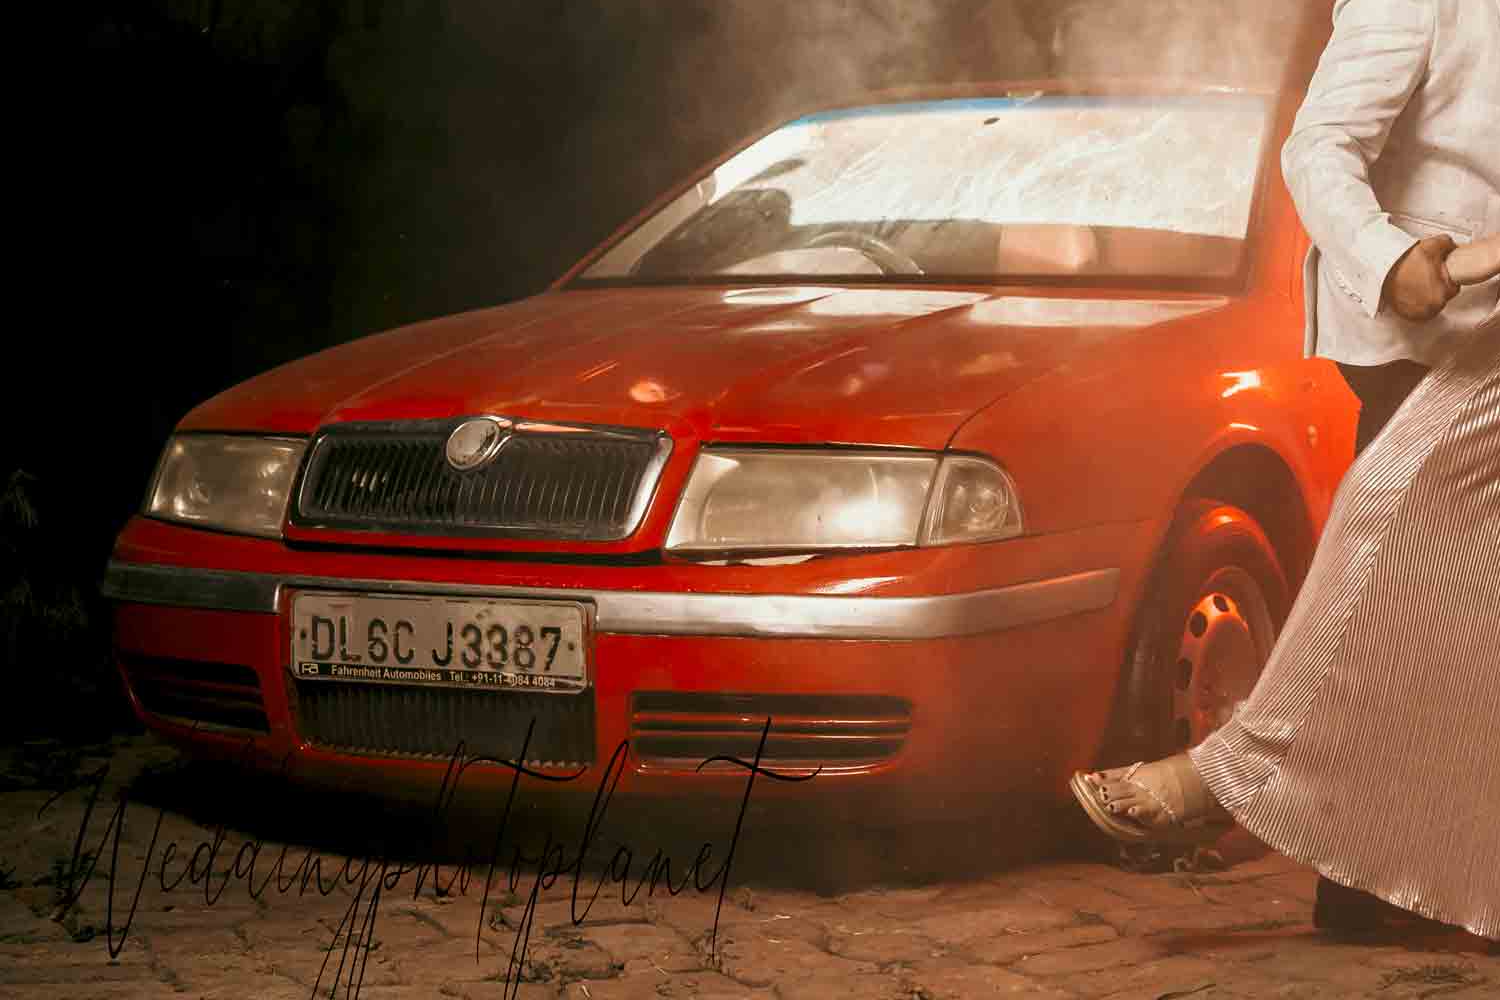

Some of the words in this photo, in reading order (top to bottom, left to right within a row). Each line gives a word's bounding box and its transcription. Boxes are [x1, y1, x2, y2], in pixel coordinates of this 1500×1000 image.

[432, 622, 562, 672] J3387
[331, 664, 381, 679] Fahrenheit
[384, 669, 441, 681] Automobiles
